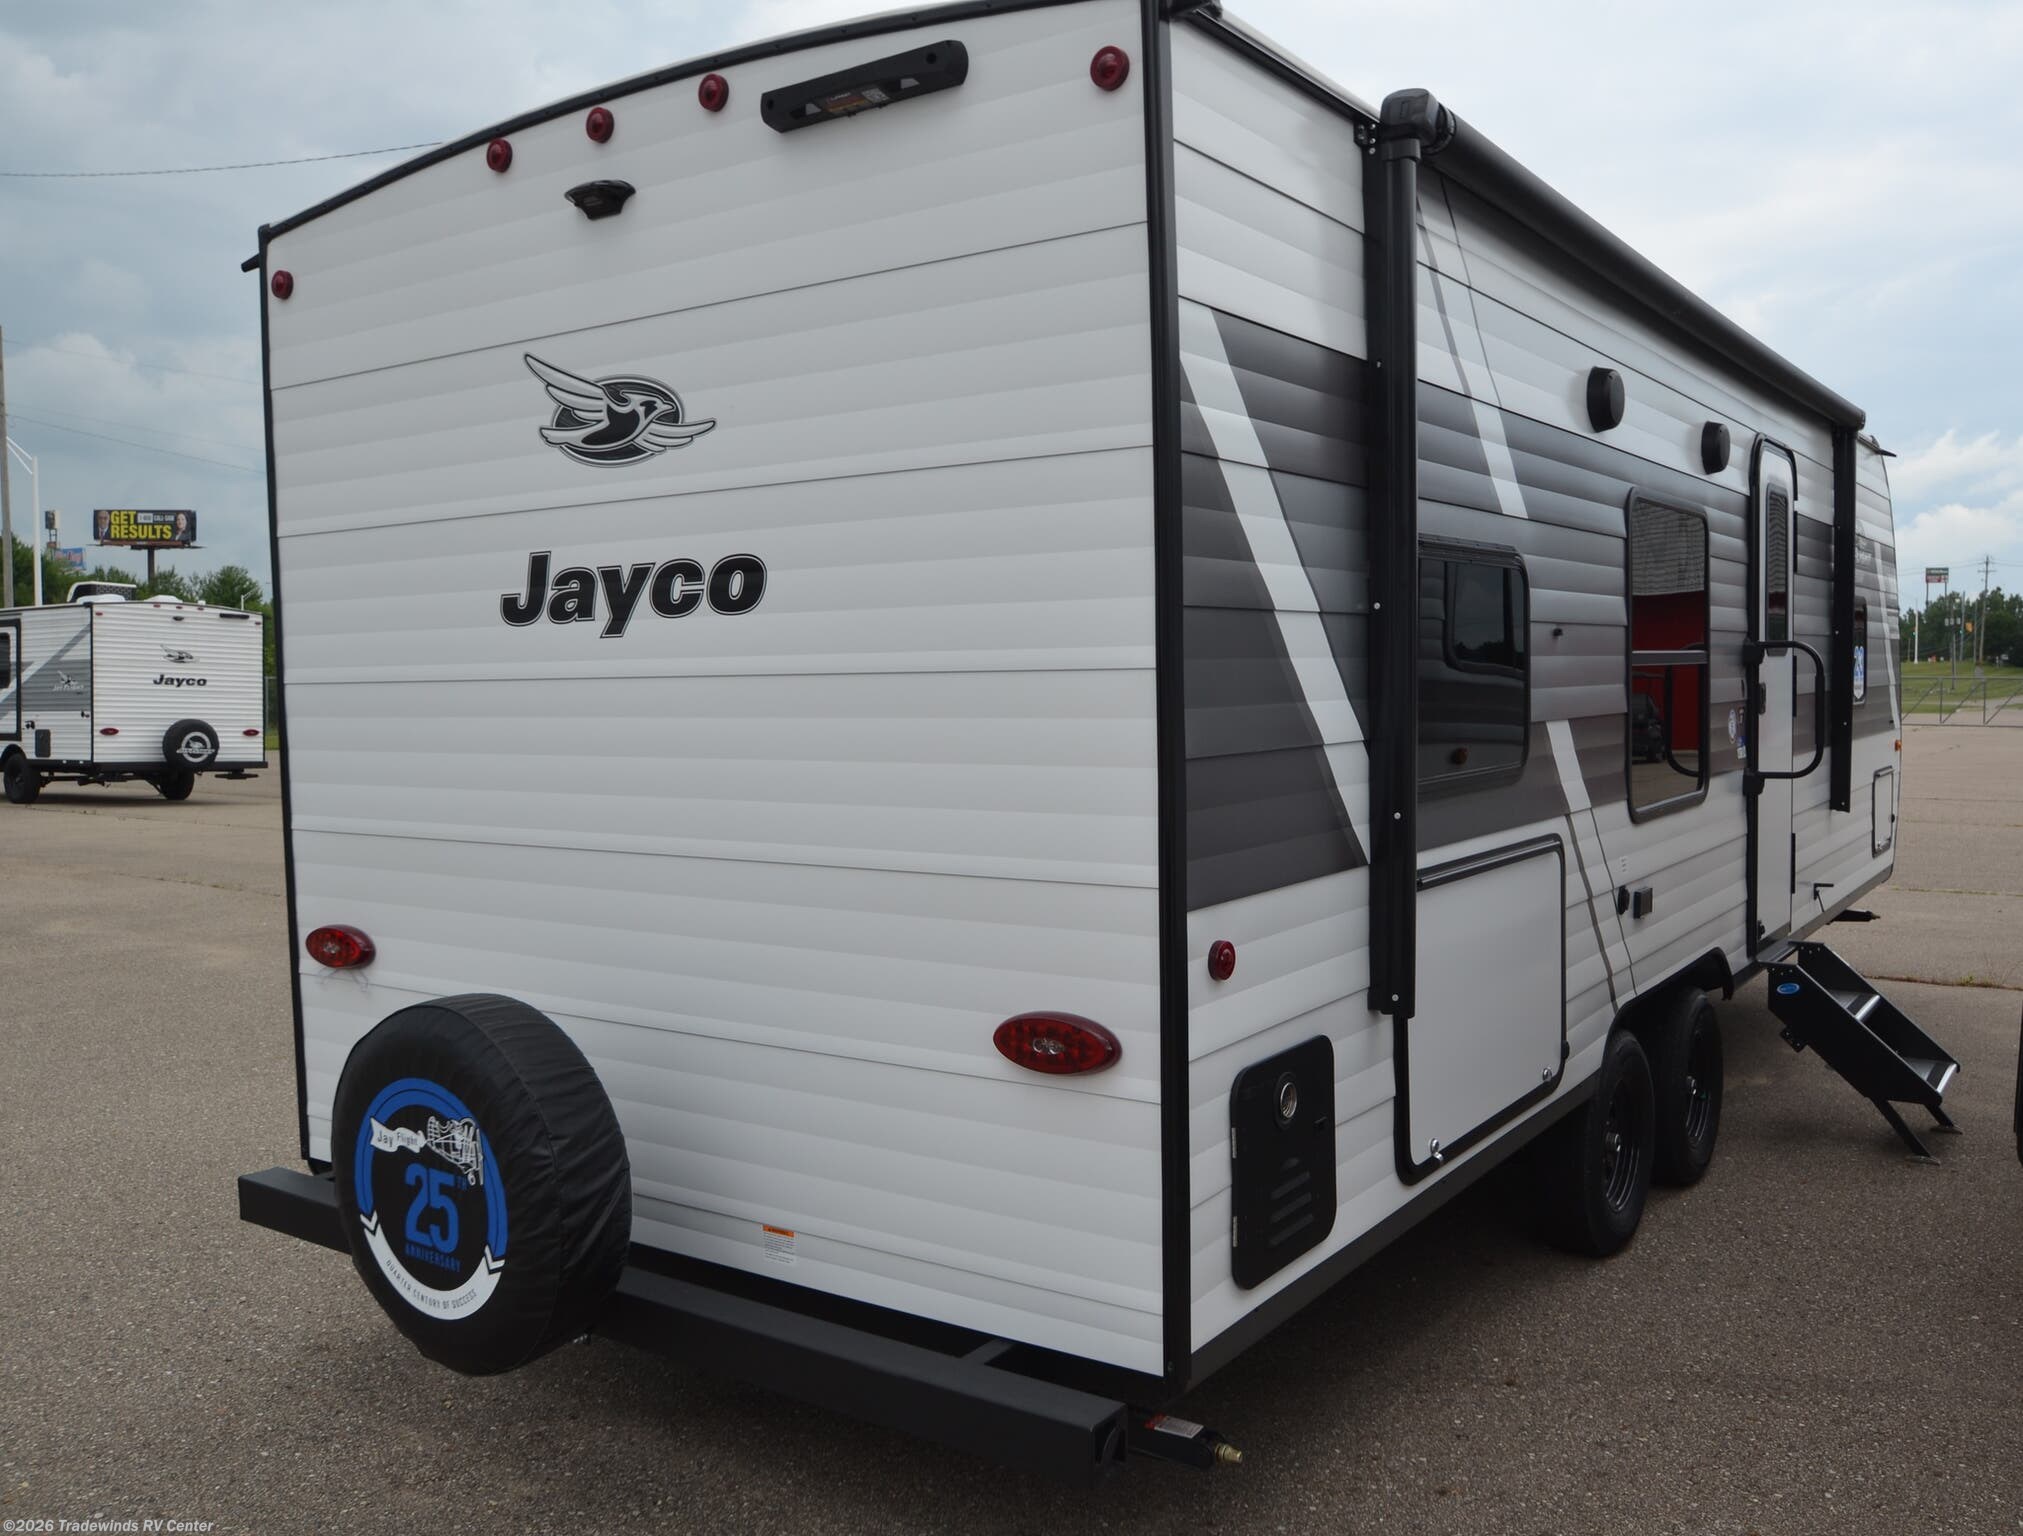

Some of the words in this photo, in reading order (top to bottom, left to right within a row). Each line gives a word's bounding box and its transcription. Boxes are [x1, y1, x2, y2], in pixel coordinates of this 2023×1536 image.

[110, 510, 136, 524] GET
[110, 525, 172, 539] RESULTS
[500, 550, 768, 639] Jayco
[153, 674, 208, 688] Jayco
[377, 1130, 394, 1148] Jay
[405, 1241, 461, 1273] ANNIVERSARY
[385, 1259, 412, 1292] QUARTER
[413, 1289, 441, 1309] CENTURY
[442, 1299, 451, 1310] OF
[451, 1288, 477, 1309] SUCCESS
